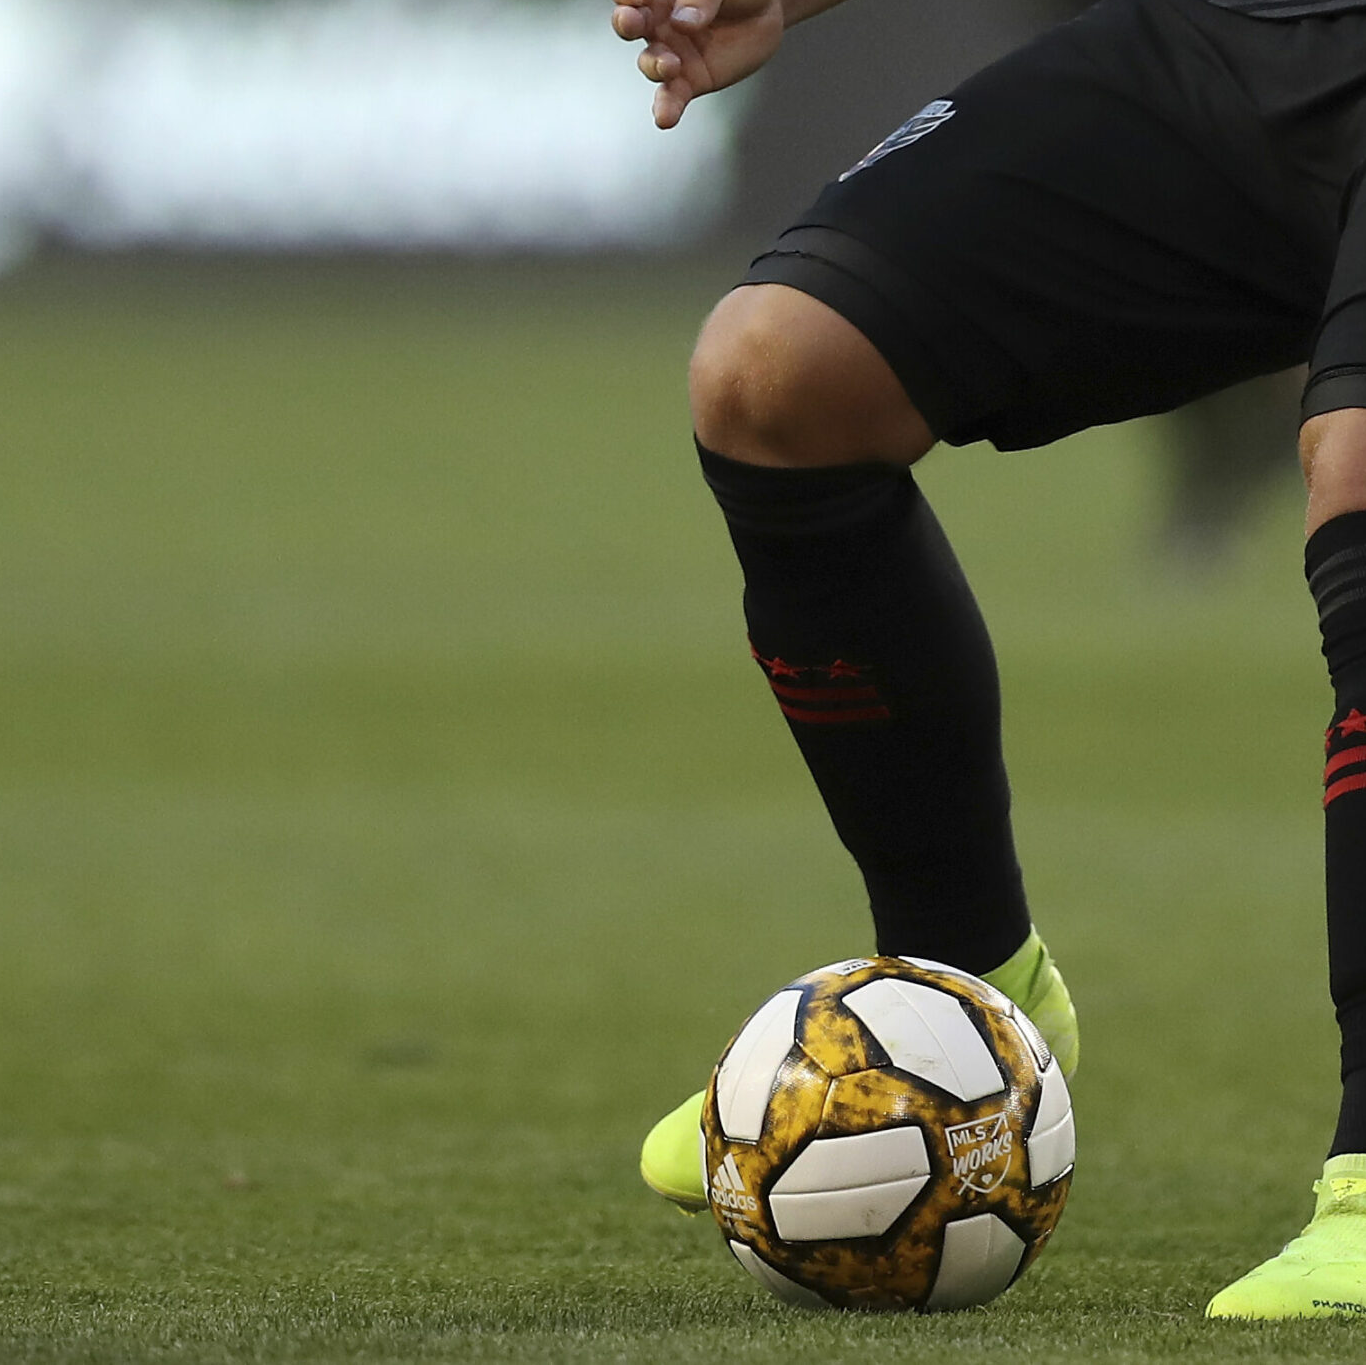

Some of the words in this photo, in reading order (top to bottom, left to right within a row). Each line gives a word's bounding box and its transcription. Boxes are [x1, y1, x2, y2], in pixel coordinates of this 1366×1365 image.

[951, 1125, 987, 1147] MLS
[952, 1130, 1013, 1177] WORKS
[711, 1187, 758, 1211] adidas
